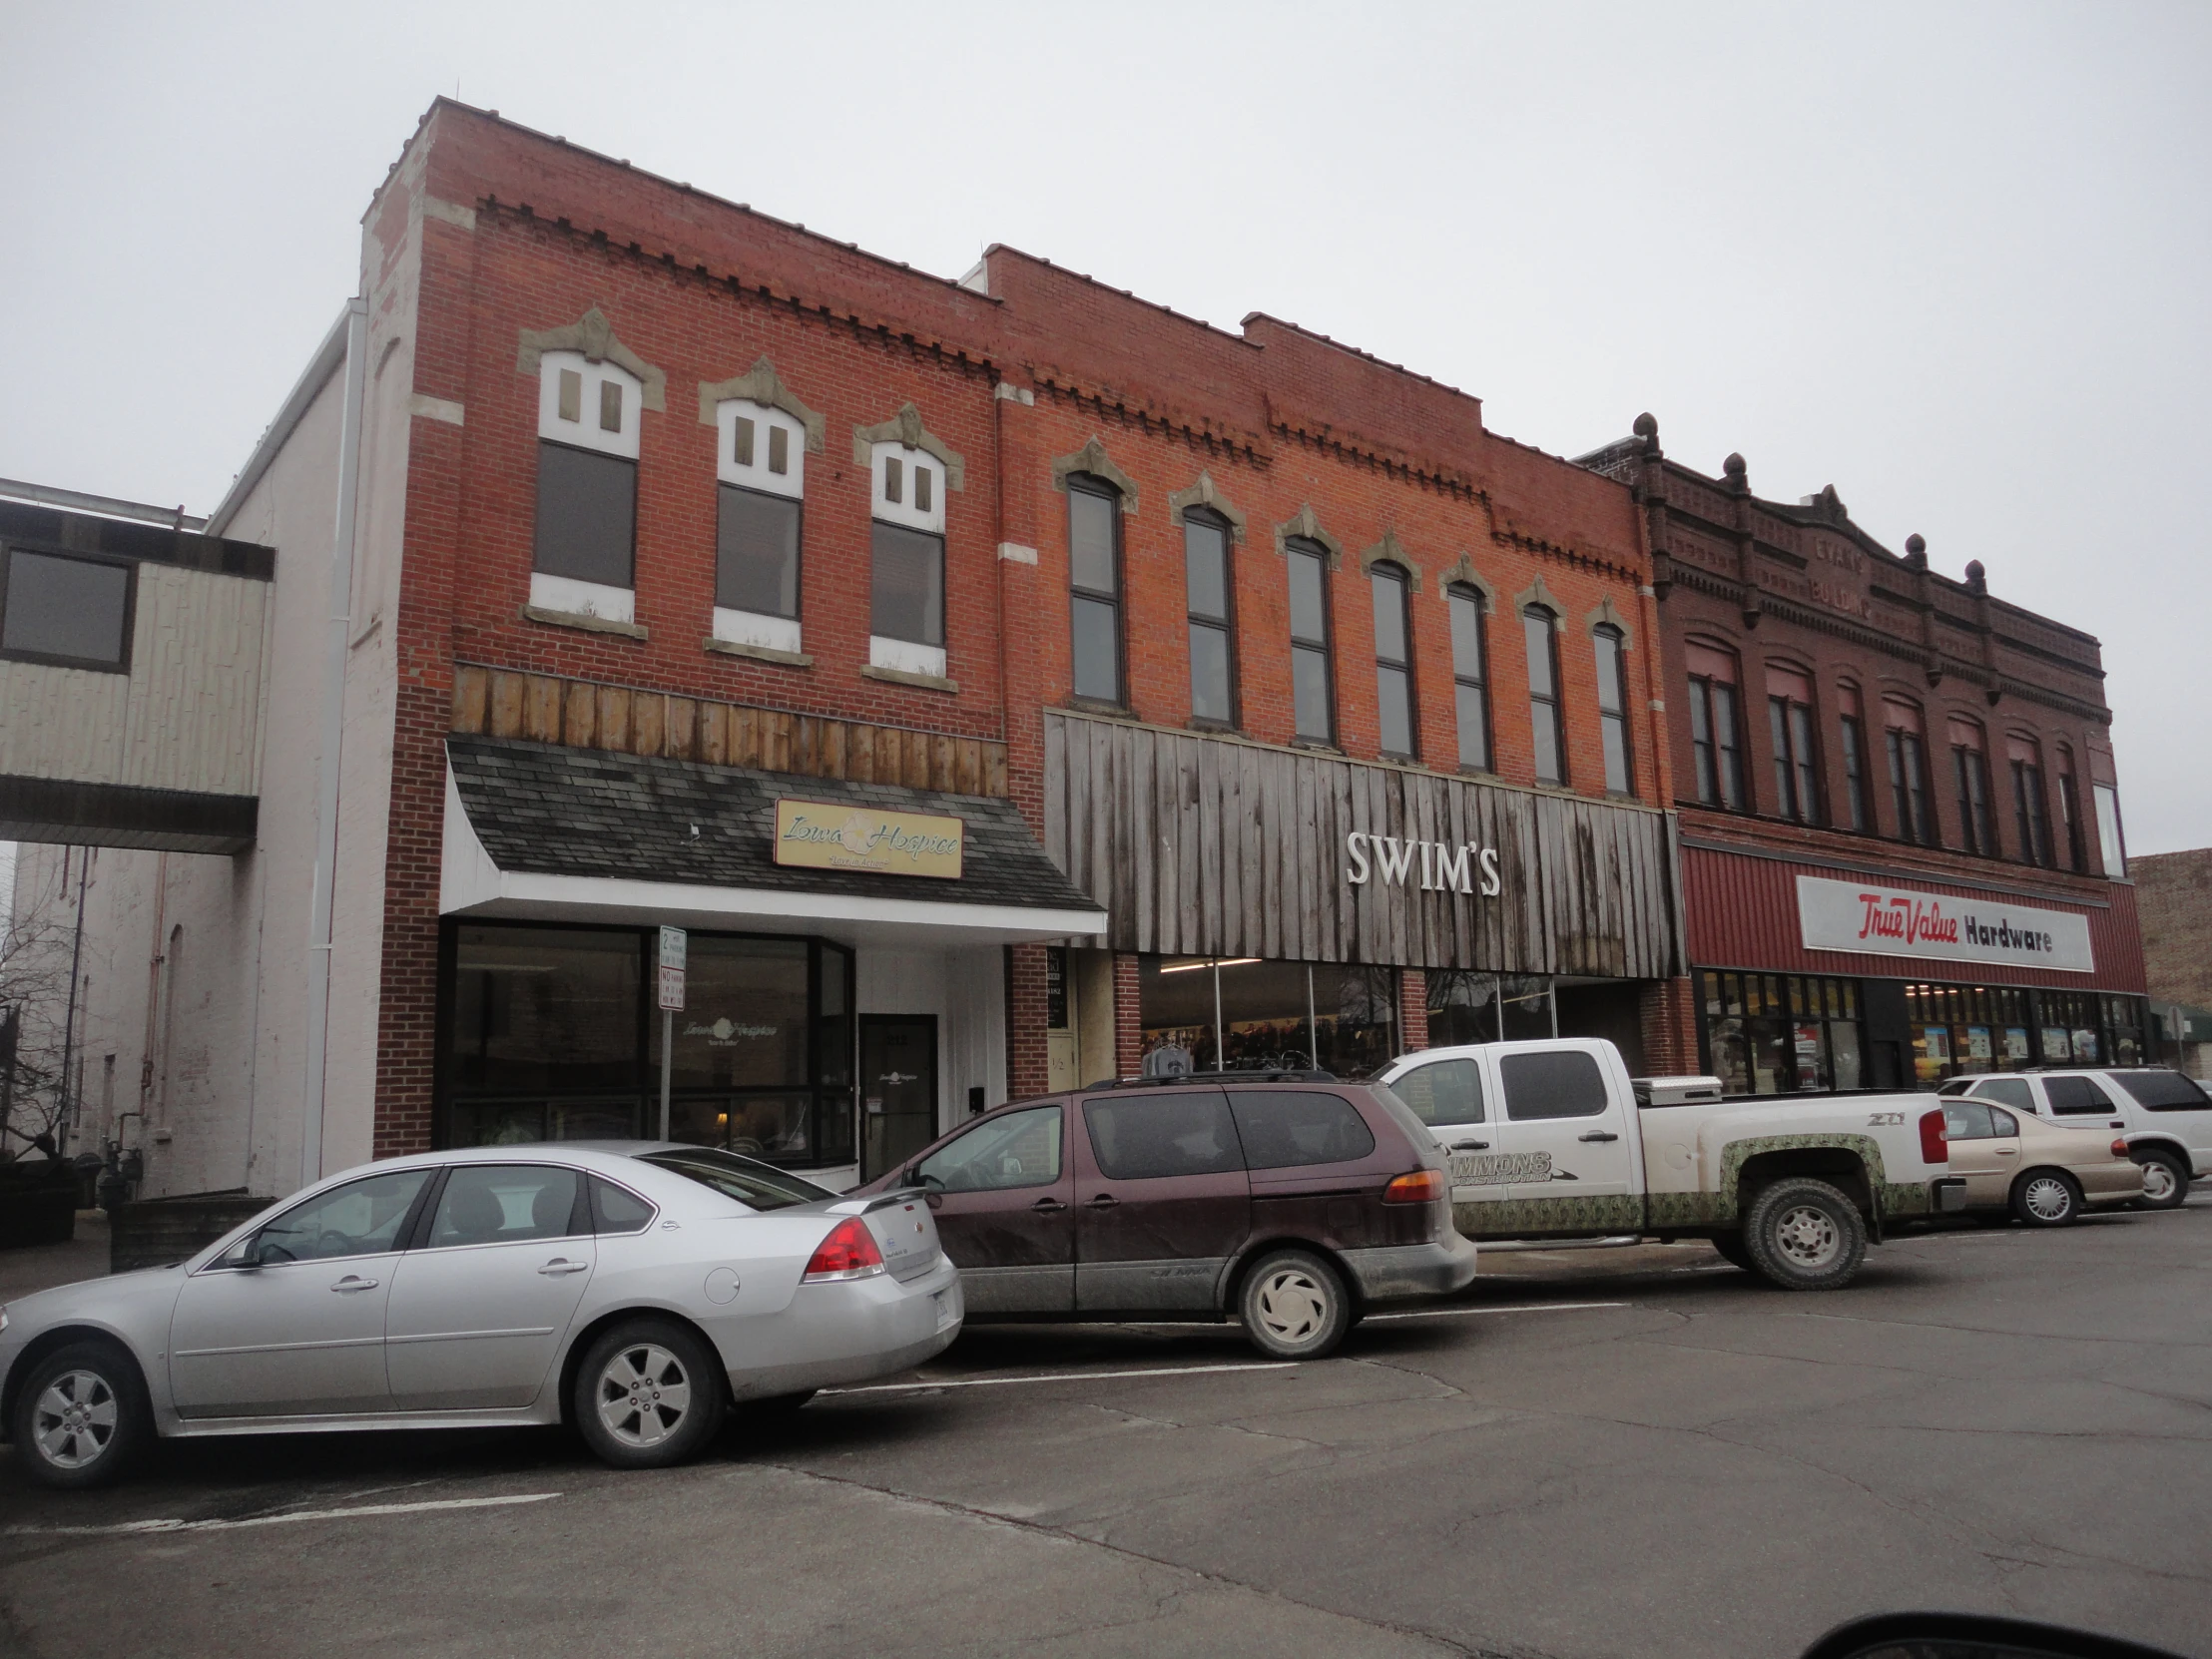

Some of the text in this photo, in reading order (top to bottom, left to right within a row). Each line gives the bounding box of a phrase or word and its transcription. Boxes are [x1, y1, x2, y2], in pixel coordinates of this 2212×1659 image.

[1815, 538, 1864, 574] EVANS
[1809, 579, 1872, 619] BUILDING
[783, 816, 958, 860] Iowa Hospice
[1347, 831, 1500, 896] SWIM'S
[663, 933, 668, 950] 2
[1963, 915, 2052, 952] Hardware
[663, 969, 670, 982] NO
[1867, 1111, 1906, 1127] Z71
[1449, 1151, 1551, 1177] IMMONS
